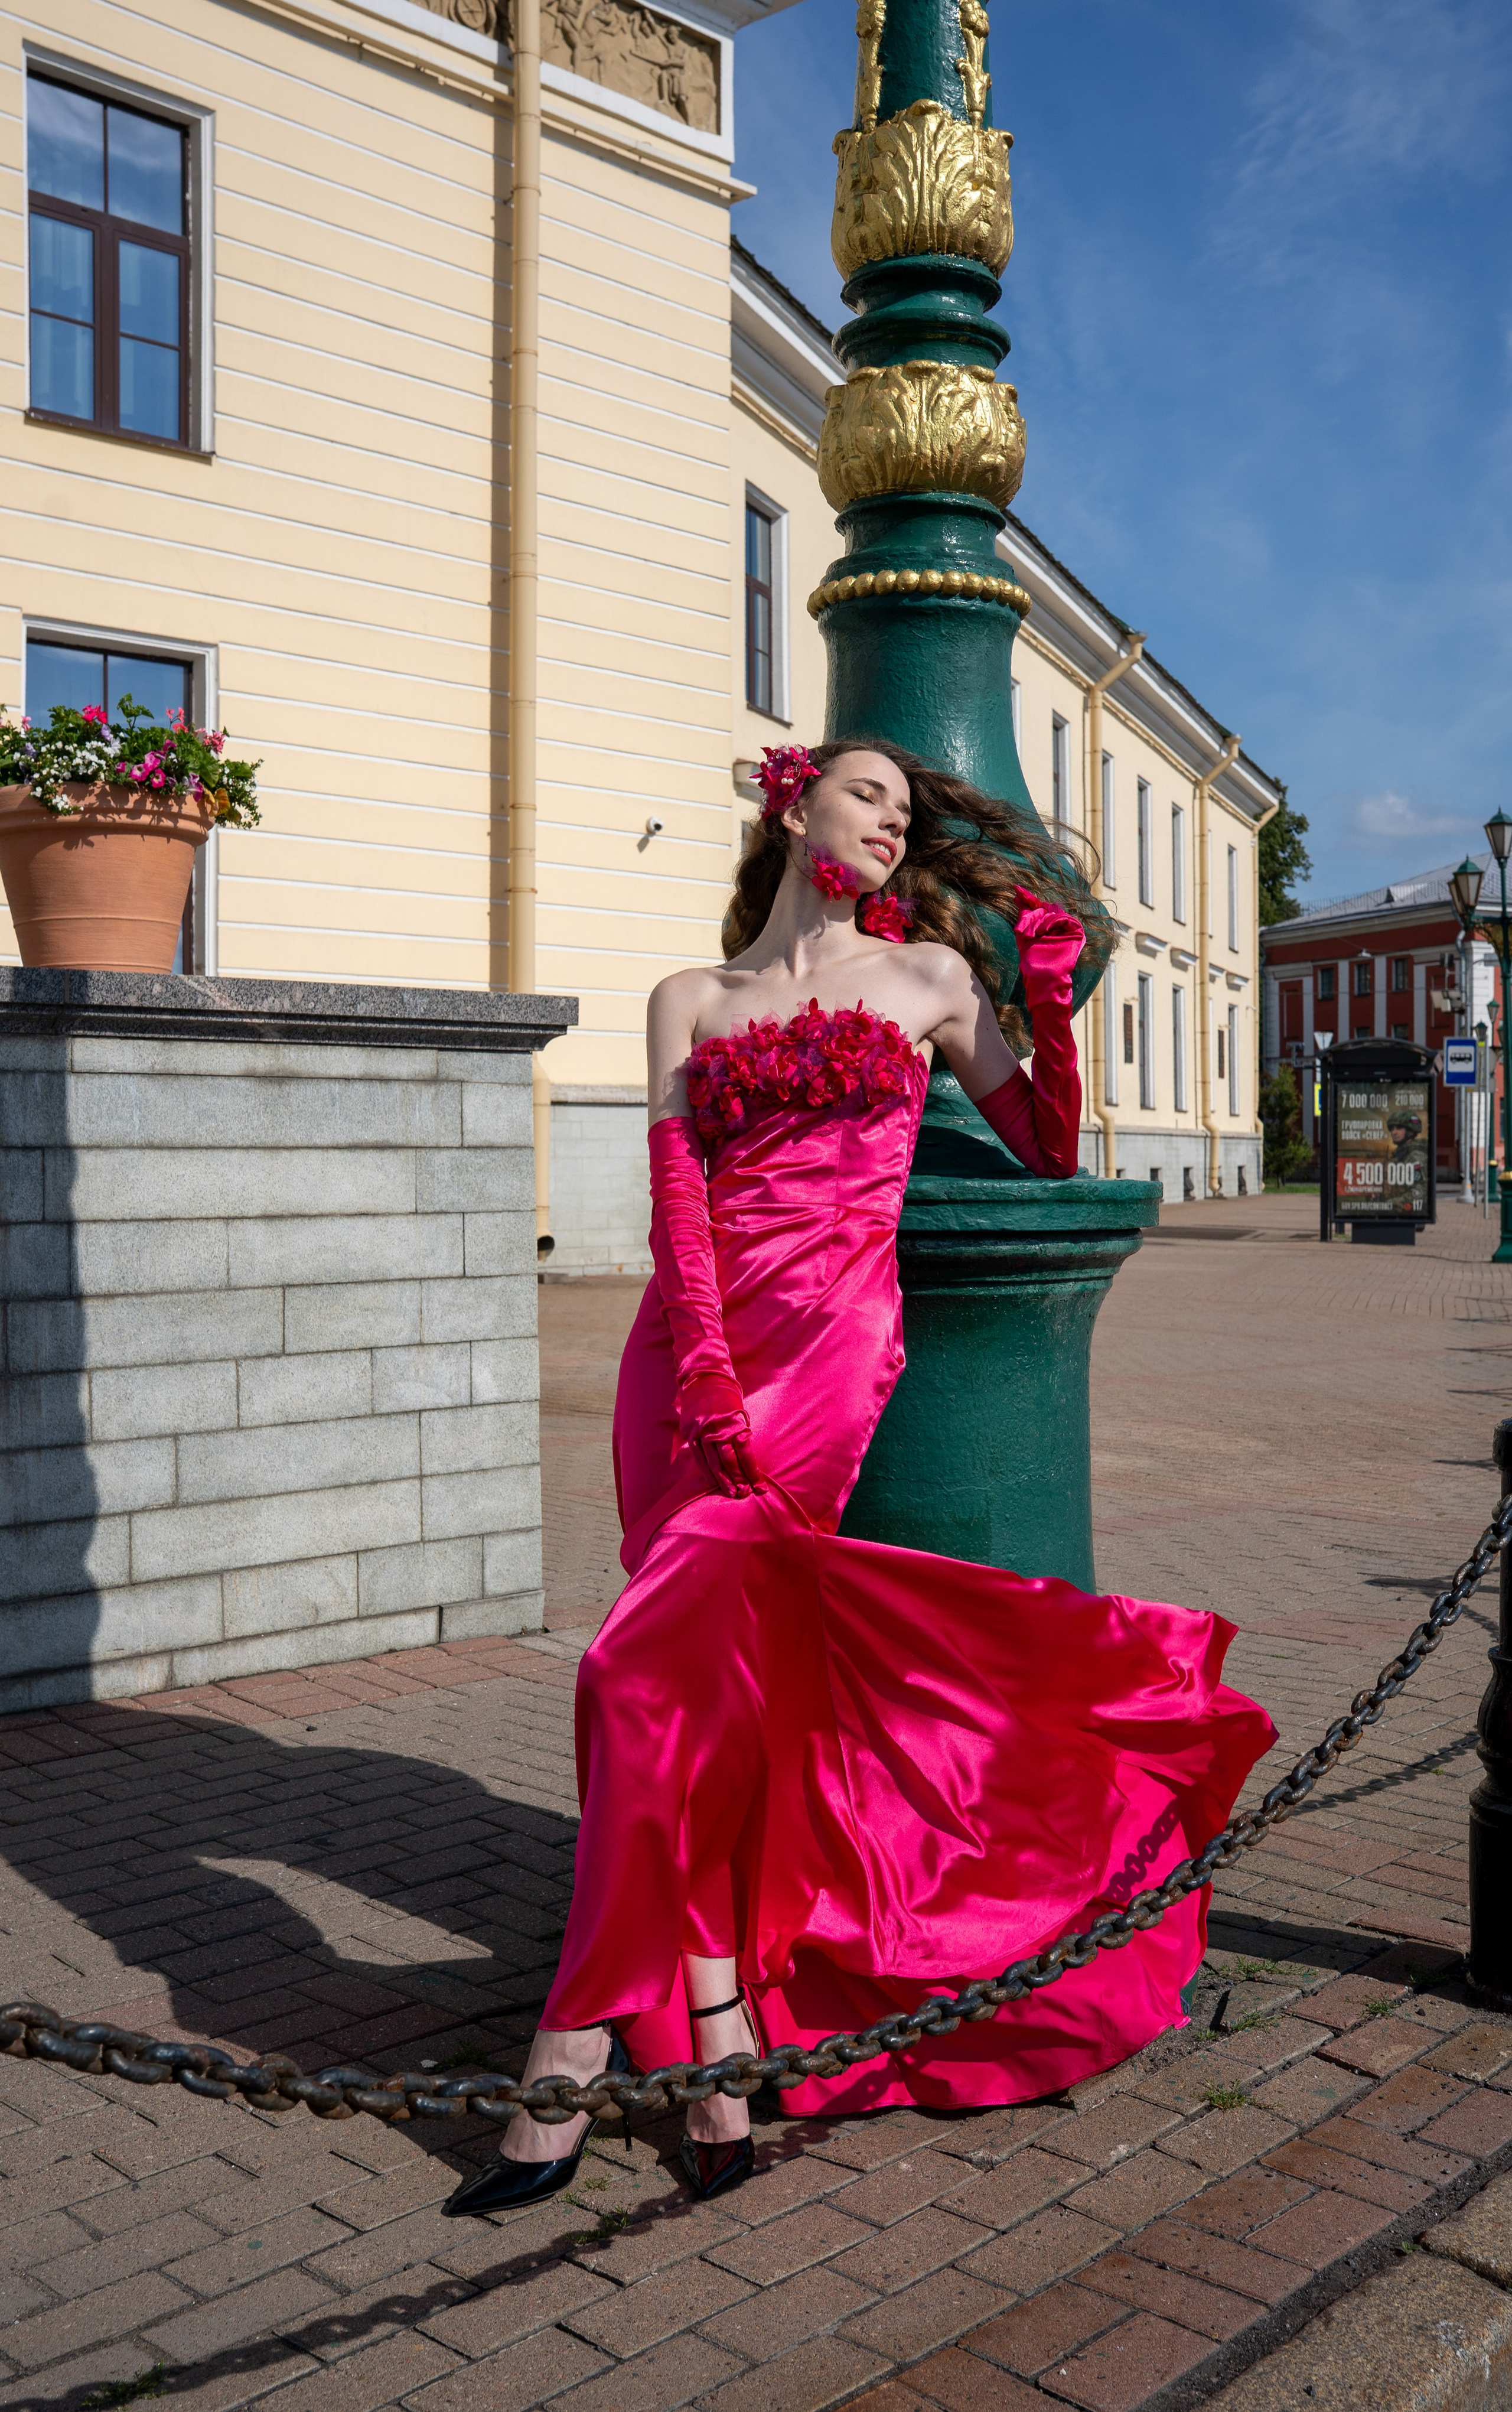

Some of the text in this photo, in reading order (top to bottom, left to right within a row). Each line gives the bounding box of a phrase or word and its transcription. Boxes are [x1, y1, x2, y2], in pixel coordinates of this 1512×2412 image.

[1349, 1094, 1367, 1108] 000
[1370, 1094, 1388, 1108] 000
[1341, 1120, 1383, 1129] ГРУППИРОВКА
[1343, 1163, 1415, 1185] 4 500 000
[1413, 1199, 1423, 1211] 117
